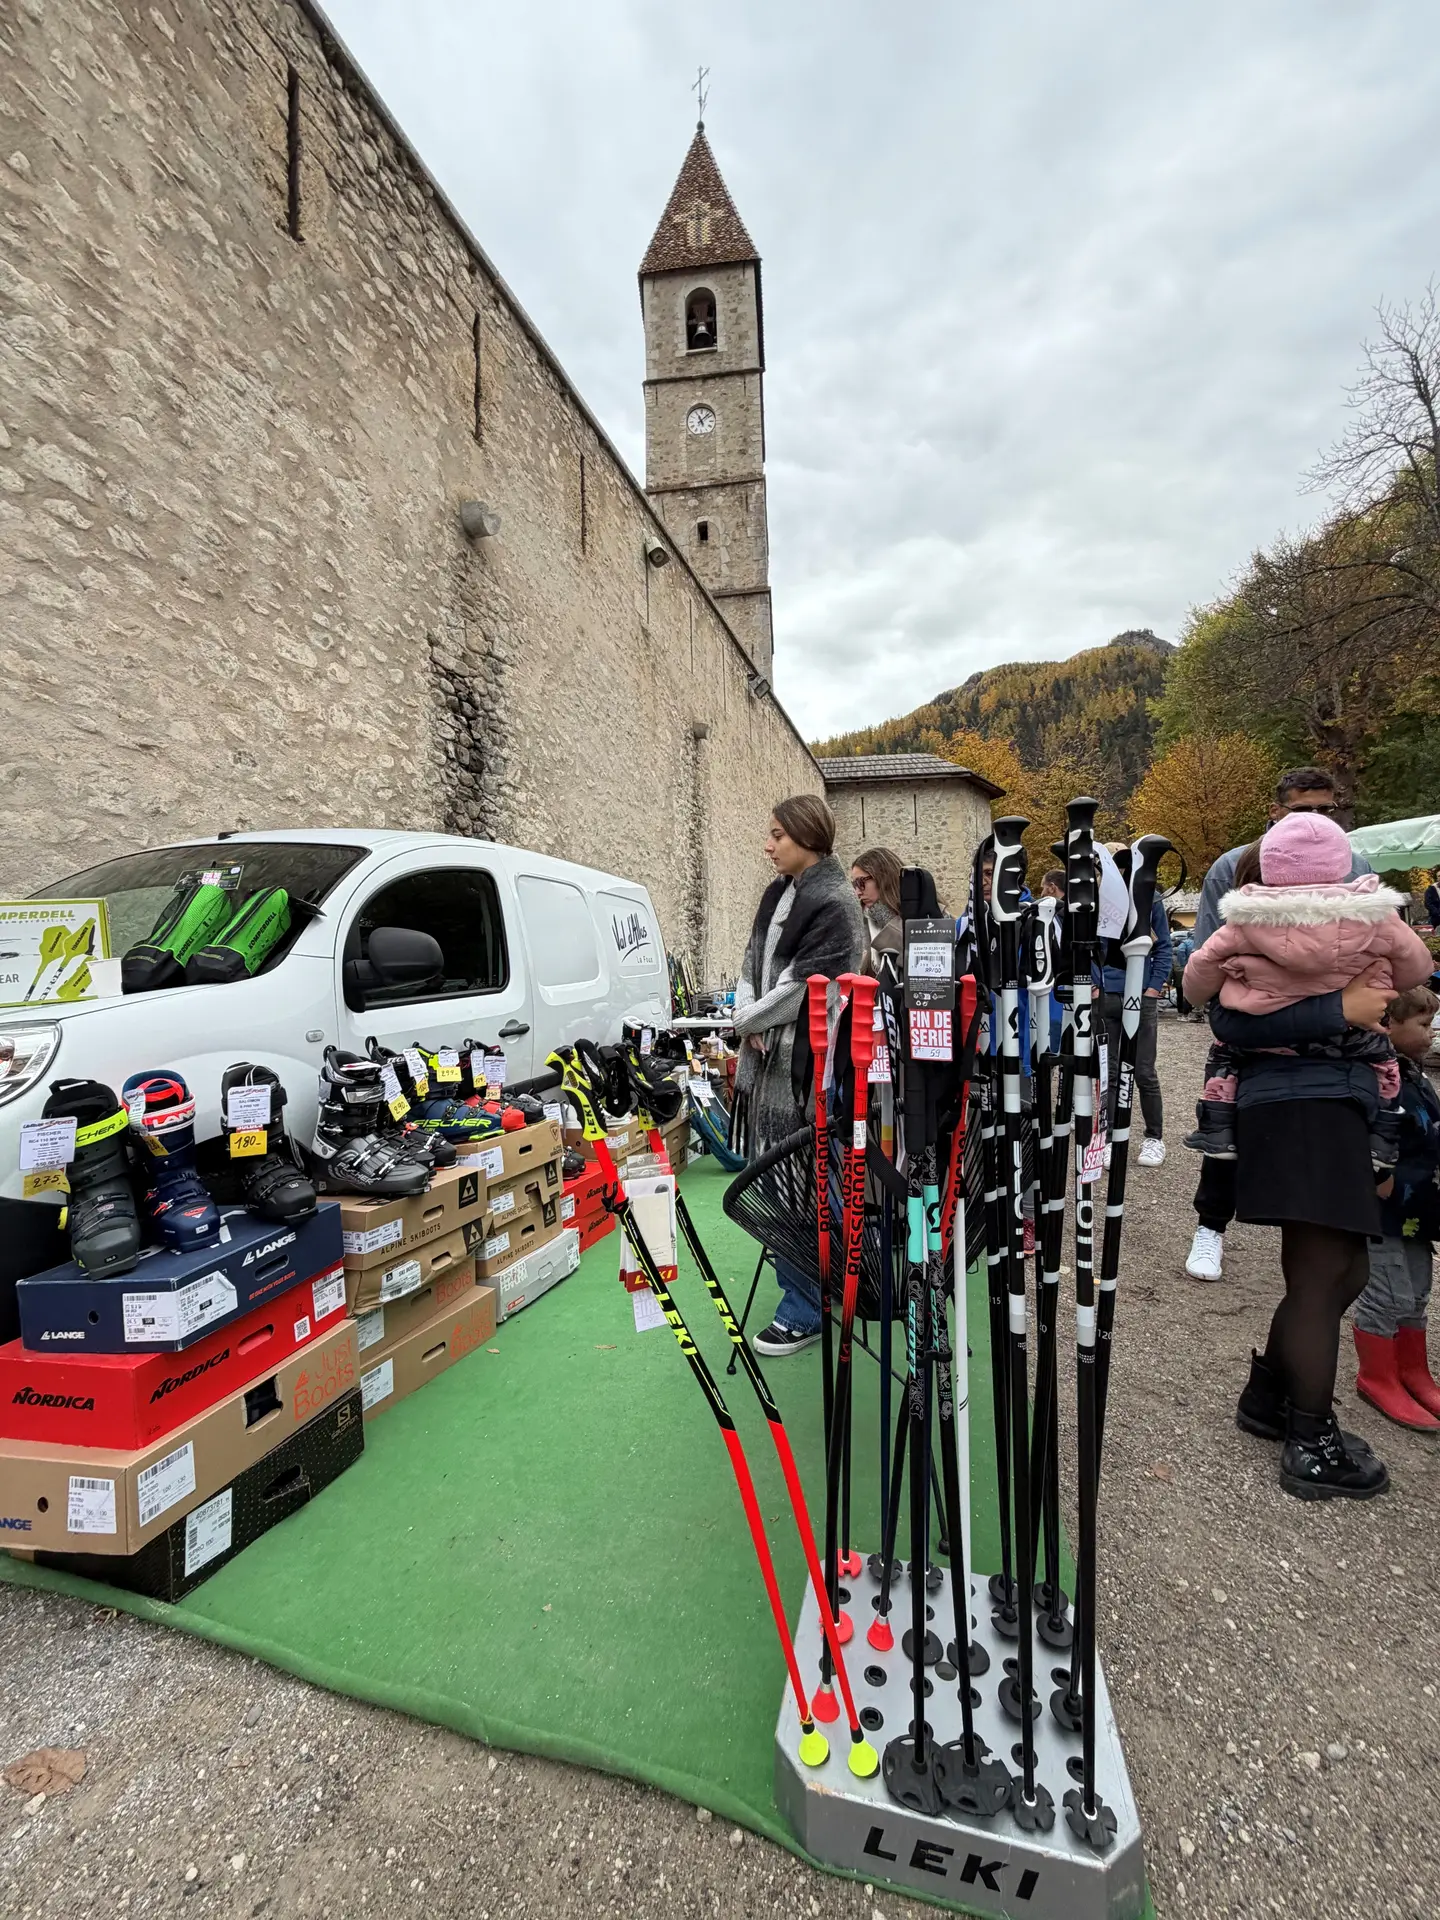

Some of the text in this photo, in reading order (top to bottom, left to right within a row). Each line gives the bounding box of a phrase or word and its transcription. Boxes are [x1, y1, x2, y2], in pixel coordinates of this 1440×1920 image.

[248, 911, 277, 950] KOMPERDELL
[612, 914, 626, 951] Val
[910, 1010, 952, 1029] FIN DE
[876, 1045, 889, 1059] DE
[911, 1028, 953, 1048] SERIE
[981, 1083, 989, 1111] VOLA
[1118, 1073, 1131, 1109] VOLA
[413, 1118, 492, 1128] FISCHER
[583, 1104, 598, 1134] LEKI
[816, 1127, 830, 1233] ROSSIGNOL
[848, 1153, 866, 1276] ROSSIGNOL
[255, 1232, 297, 1258] LANGE
[381, 1238, 407, 1255] ALPINE
[410, 1223, 441, 1242] SKIBOOTS
[635, 1269, 674, 1285] LKI
[656, 1293, 697, 1355] LEKI
[704, 1280, 743, 1343] LEKI
[51, 1331, 86, 1340] LANGE
[150, 1348, 230, 1404] NORDICA
[12, 1387, 95, 1411] NORDICA
[293, 1363, 355, 1422] Boots
[863, 1826, 1040, 1901] LEKI
